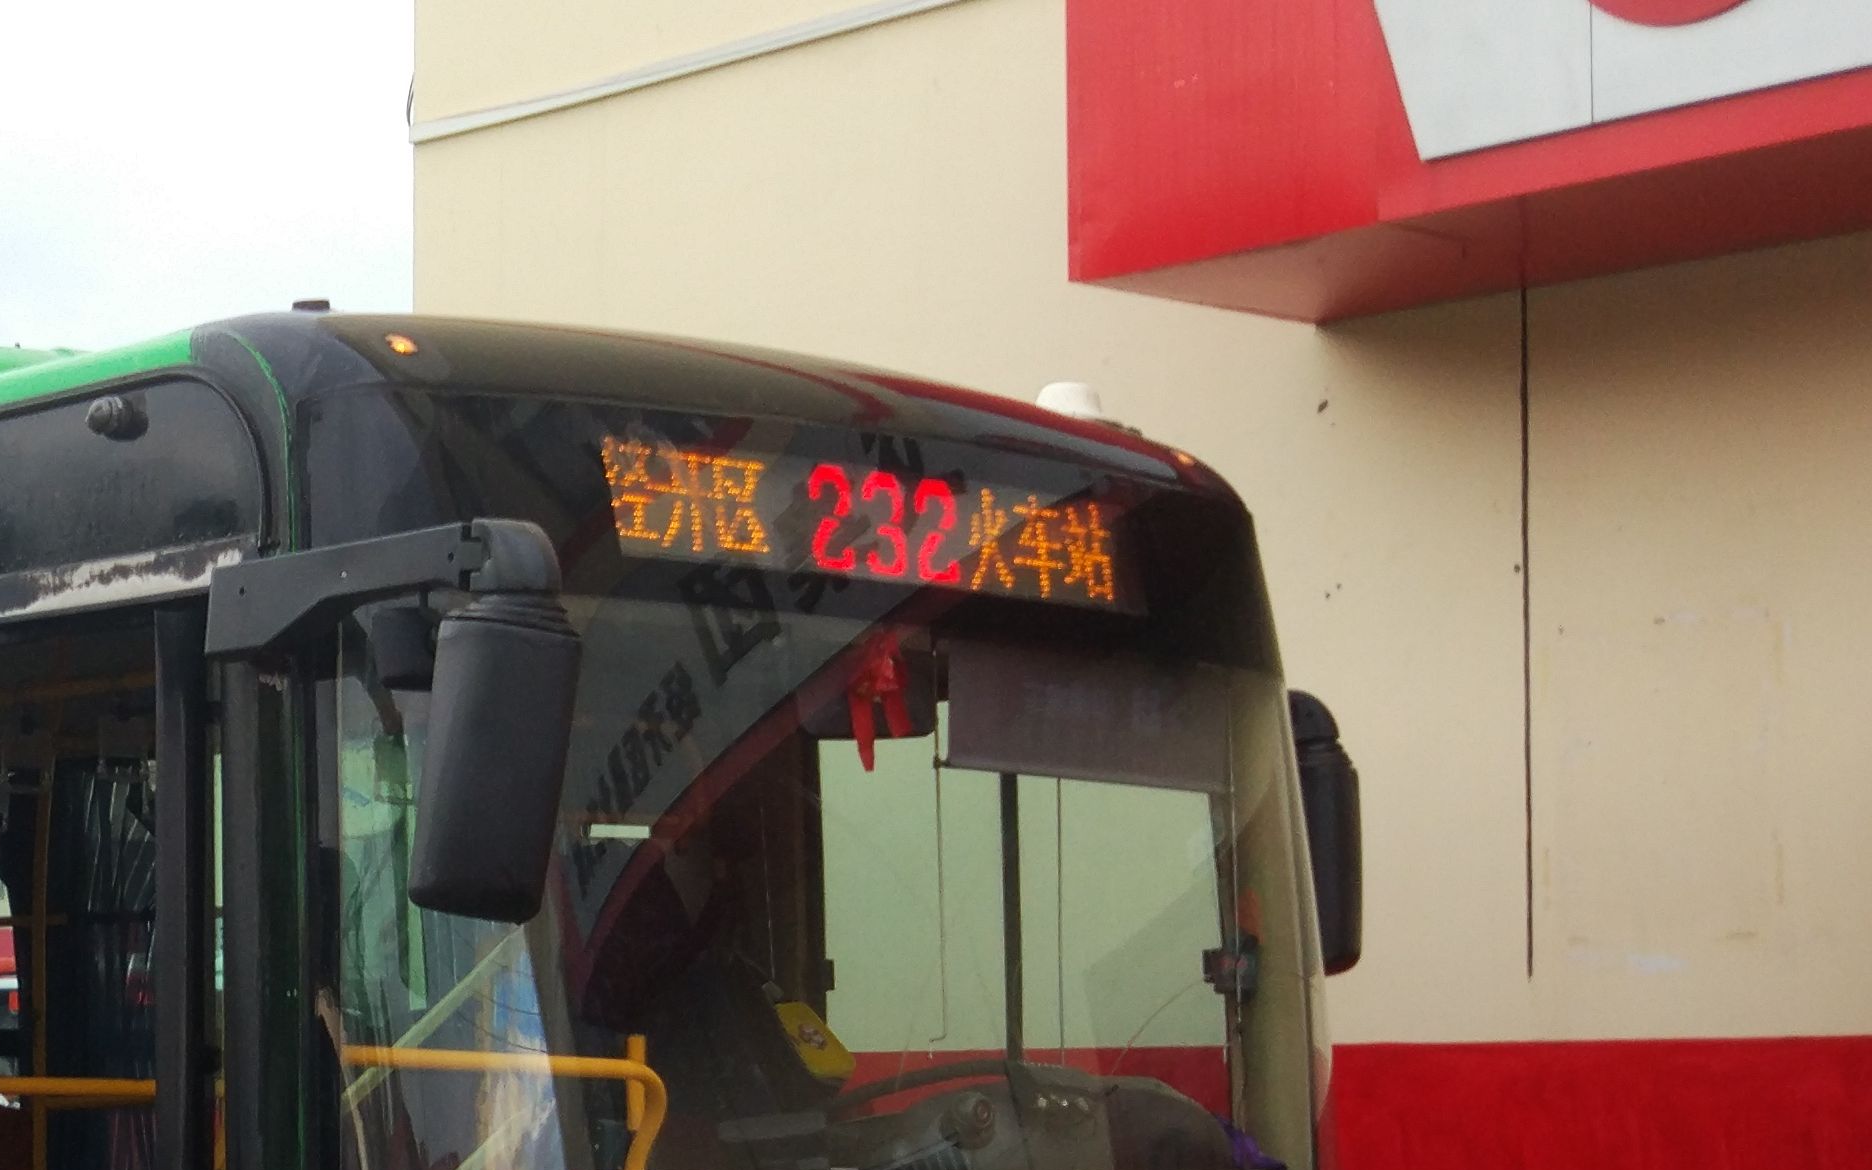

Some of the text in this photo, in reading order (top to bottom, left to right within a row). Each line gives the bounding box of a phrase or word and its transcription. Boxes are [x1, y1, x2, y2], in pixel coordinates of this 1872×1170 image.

[808, 464, 961, 584] 232
[969, 487, 1114, 601] 火车站
